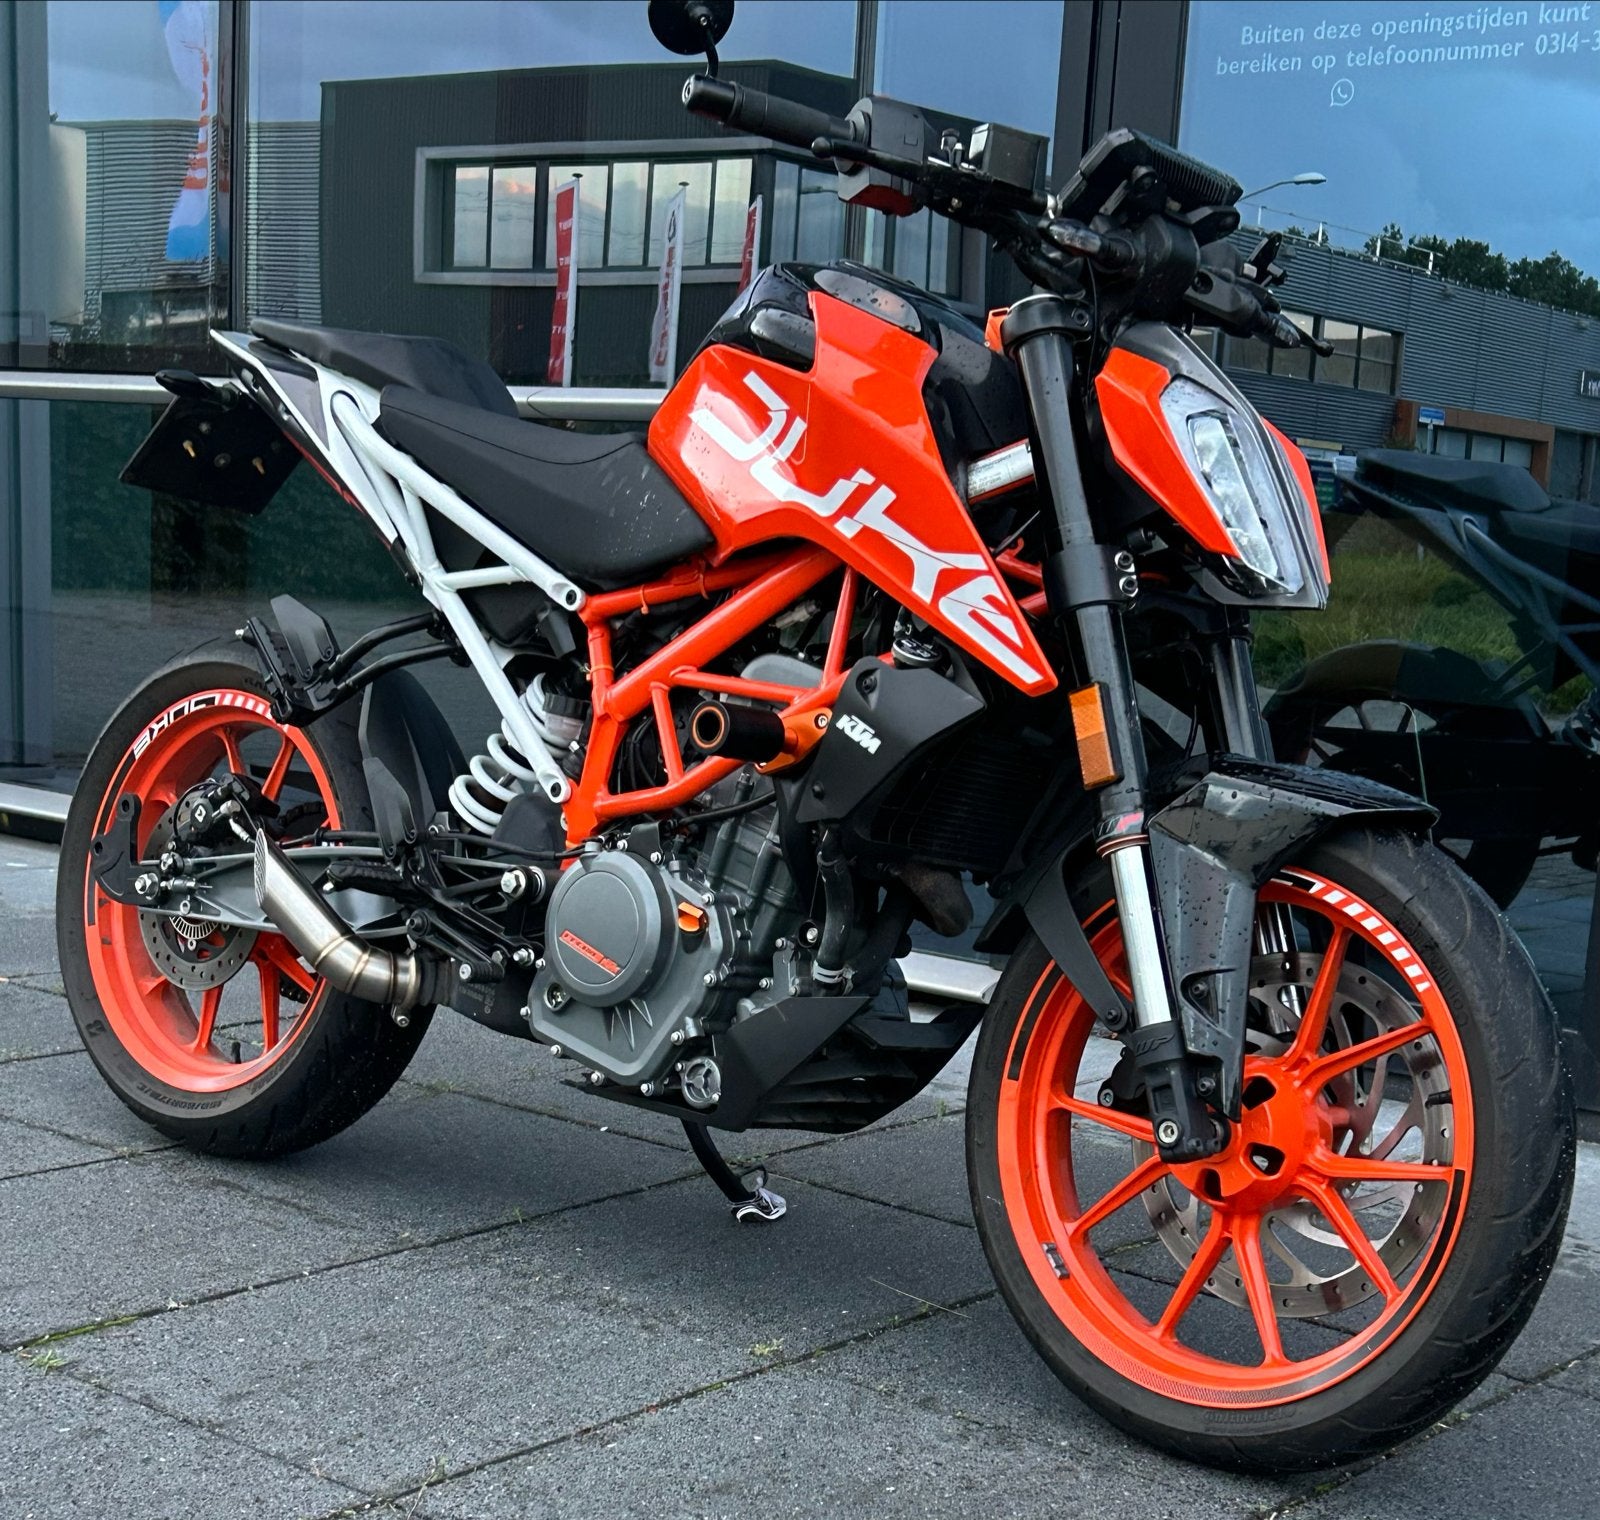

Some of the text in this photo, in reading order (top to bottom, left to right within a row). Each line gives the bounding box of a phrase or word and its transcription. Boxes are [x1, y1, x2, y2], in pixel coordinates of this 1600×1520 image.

[1241, 2, 1591, 46] Buiten deze openingstijden kunt
[1216, 53, 1302, 75] bereiken
[1311, 54, 1336, 74] op
[1346, 41, 1524, 67] telefoonnummer
[836, 714, 882, 755] KTM
